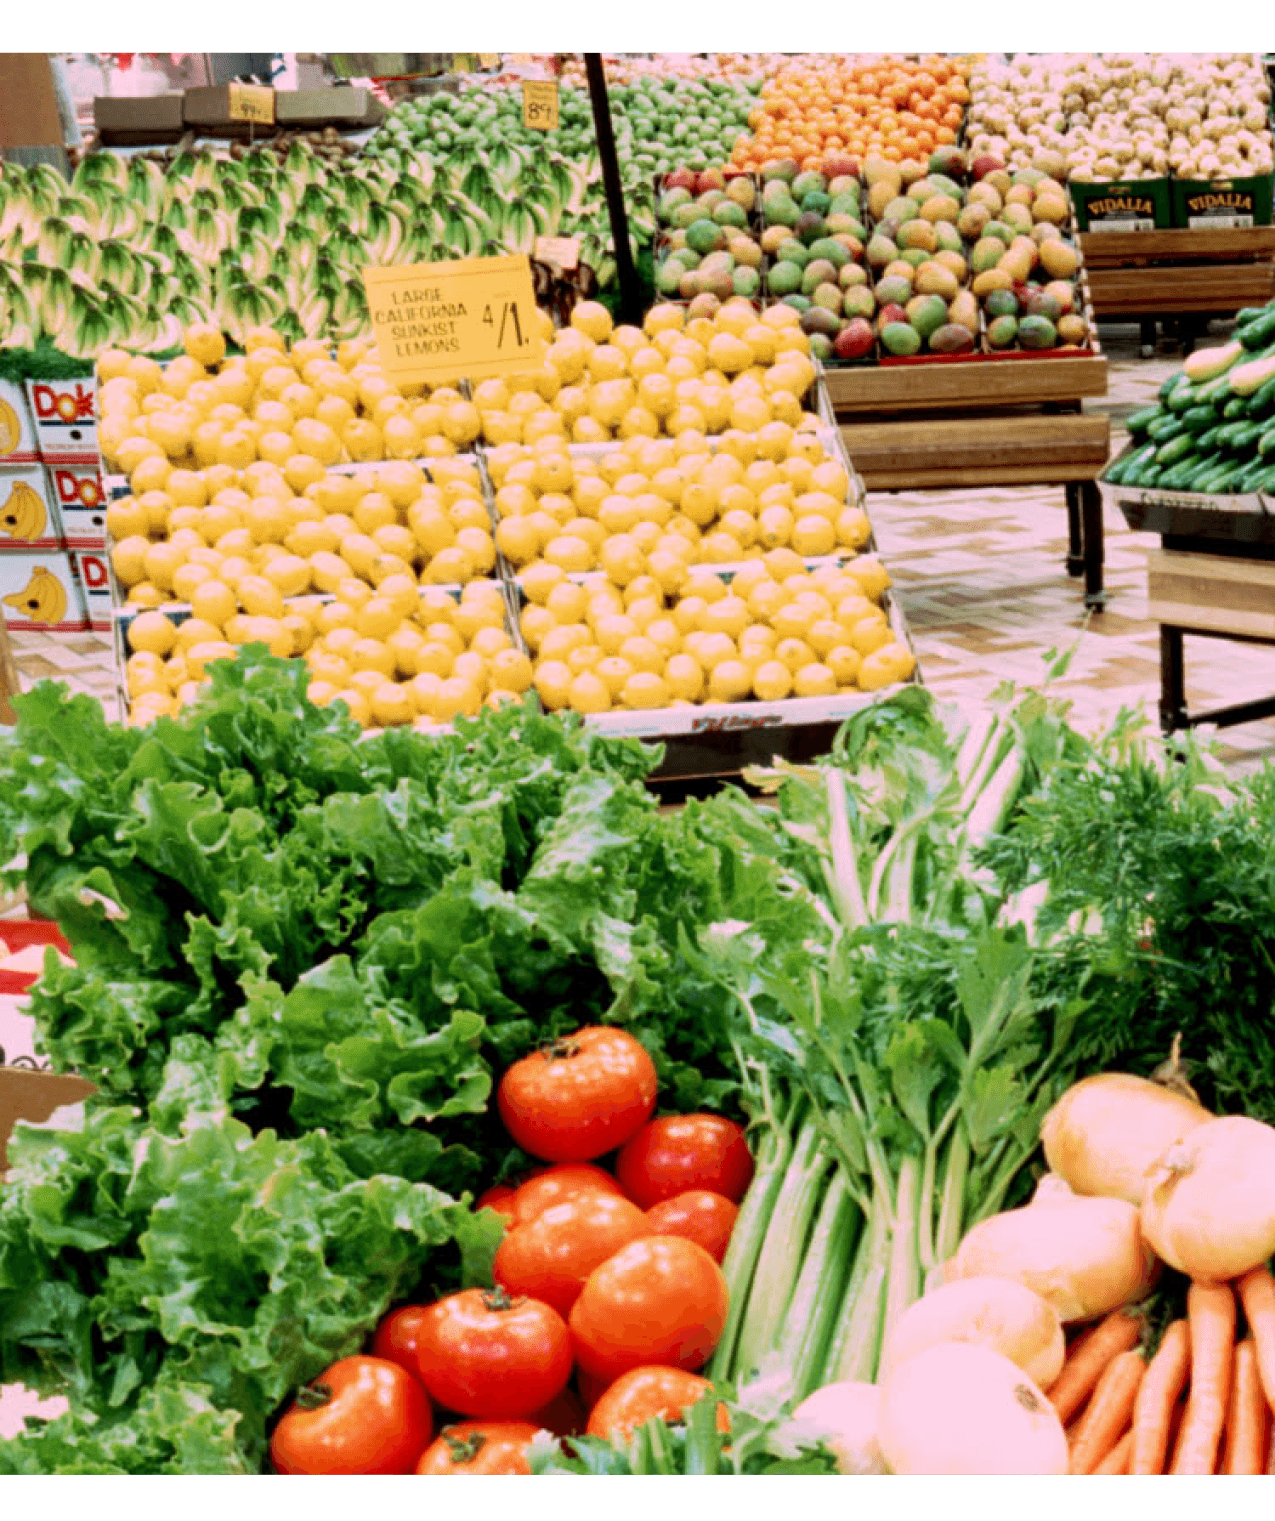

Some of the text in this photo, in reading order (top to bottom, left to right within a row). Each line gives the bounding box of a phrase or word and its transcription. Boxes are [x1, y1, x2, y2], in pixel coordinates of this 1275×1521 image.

[1087, 196, 1152, 215] VIDALIA
[1187, 192, 1252, 211] VIDALIA
[391, 287, 442, 305] LARGE
[375, 302, 468, 325] CALIFORNIA
[390, 321, 455, 340] SUNKIST
[395, 336, 460, 357] LEMONS
[55, 470, 106, 508] Dol
